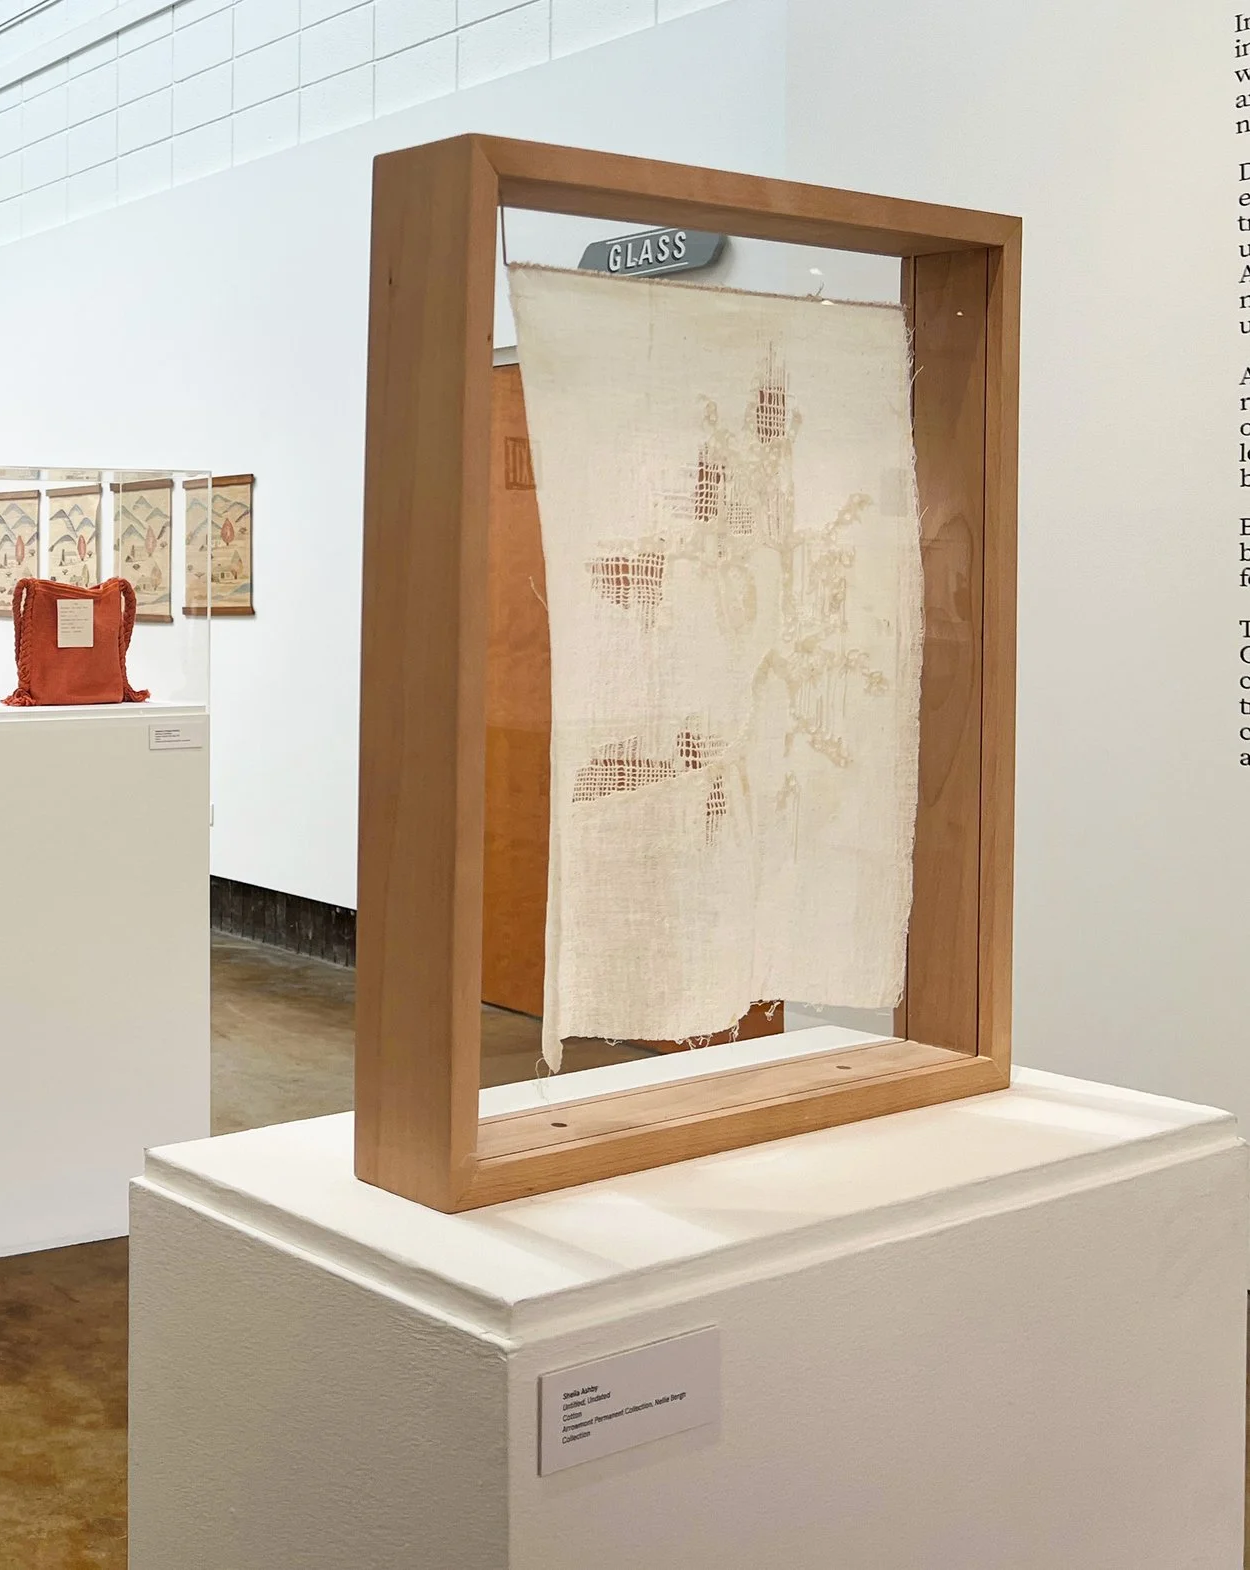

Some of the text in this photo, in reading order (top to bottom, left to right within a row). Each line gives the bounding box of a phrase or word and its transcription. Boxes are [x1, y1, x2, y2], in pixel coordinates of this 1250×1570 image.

[608, 231, 687, 272] GLASS
[562, 1385, 599, 1401] Sheila Ashby
[587, 1391, 611, 1404] Undated
[562, 1411, 582, 1422] Cotton
[594, 1409, 624, 1424] Permanent
[562, 1431, 591, 1444] Collection
